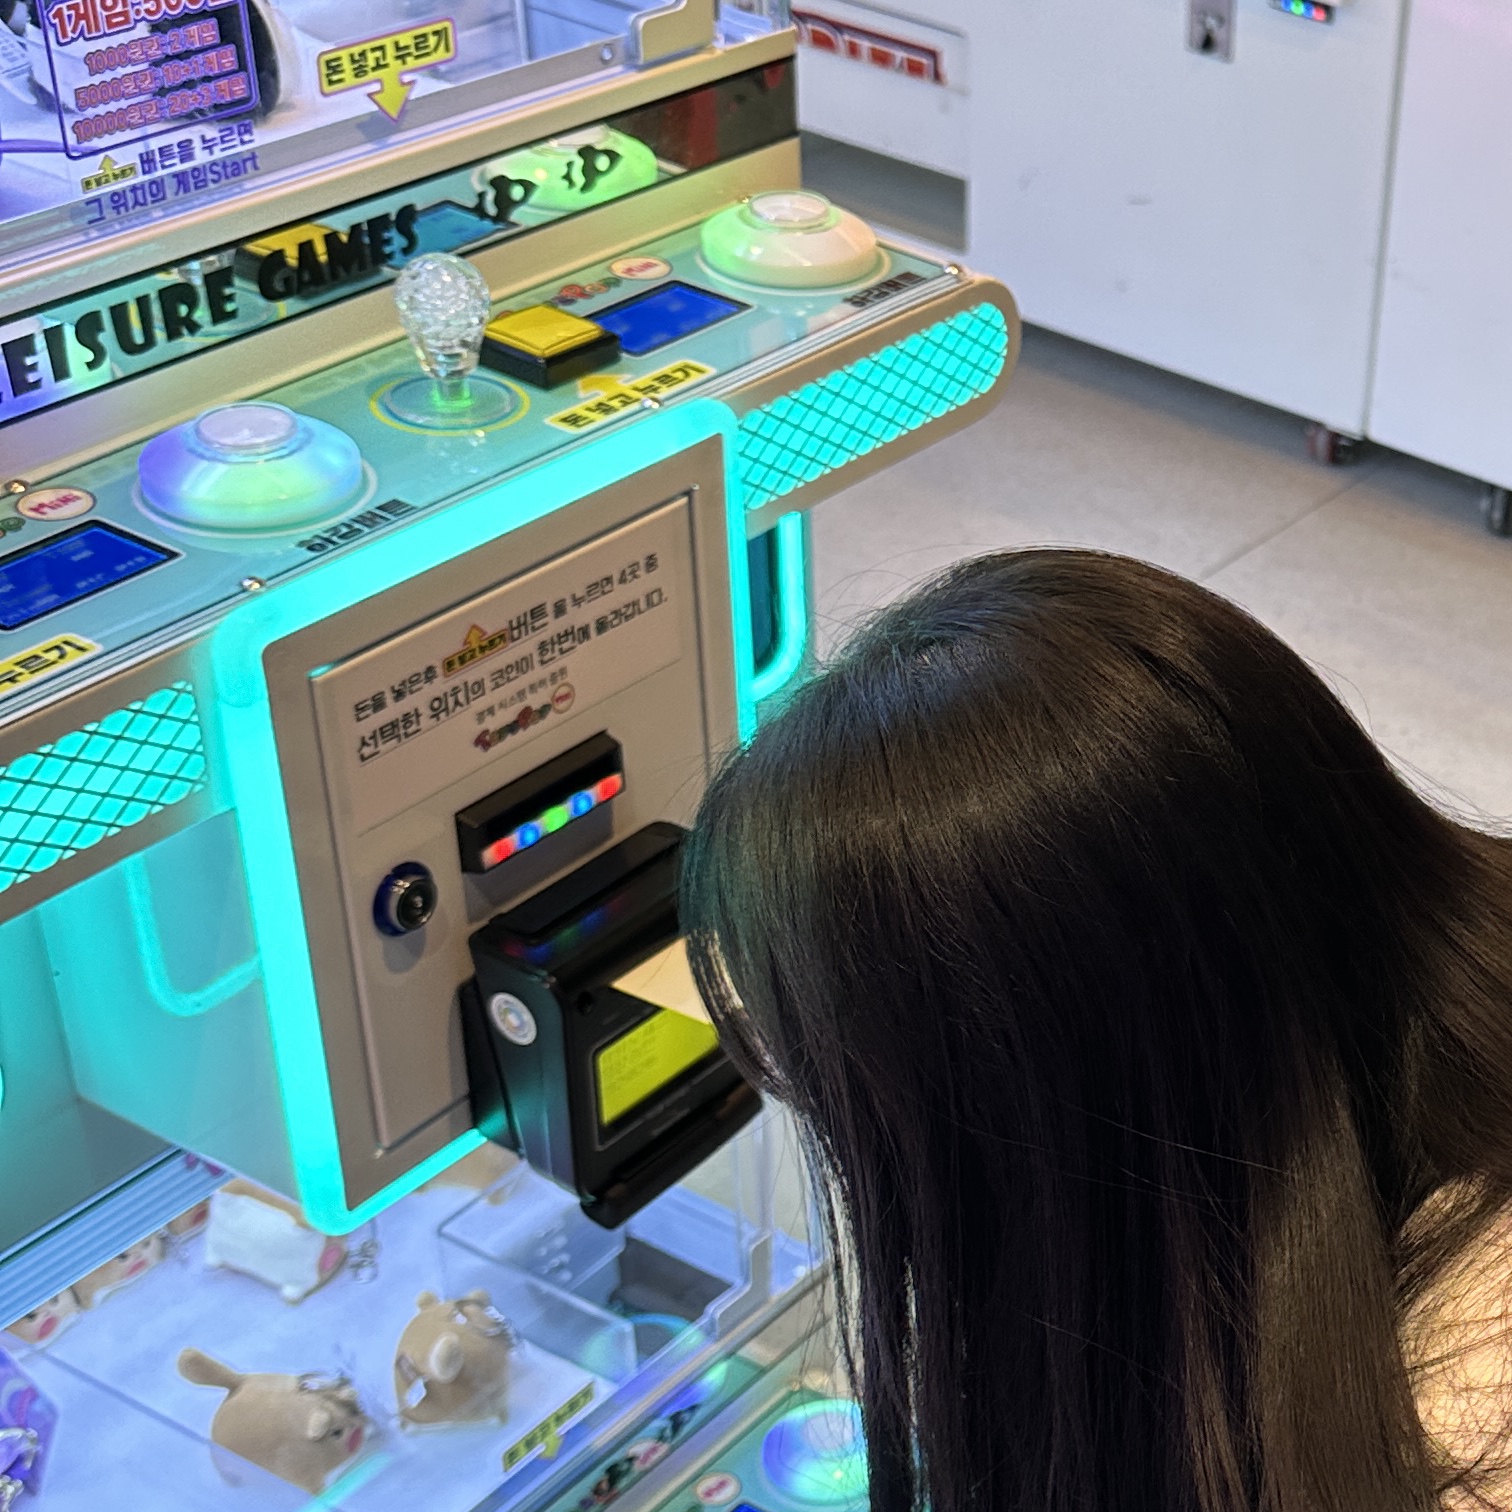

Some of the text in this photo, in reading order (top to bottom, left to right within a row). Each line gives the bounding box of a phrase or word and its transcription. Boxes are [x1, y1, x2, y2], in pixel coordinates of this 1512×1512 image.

[169, 31, 181, 52] 2
[184, 19, 218, 47] 게임
[203, 47, 236, 73] 게임
[325, 26, 451, 87] 돈 넣고 누르기
[214, 75, 248, 102] 게임
[138, 138, 196, 176] 버튼을
[201, 119, 255, 156] 누르면
[84, 151, 261, 225] 그 위치의 게임Start
[0, 203, 421, 400] EISURE GAMES
[632, 364, 706, 397] 누르기
[507, 602, 550, 644] 버튼
[570, 573, 615, 609] 누르면
[356, 706, 424, 764] 선택한
[427, 677, 488, 723] 위치의
[537, 623, 592, 667] 한번에
